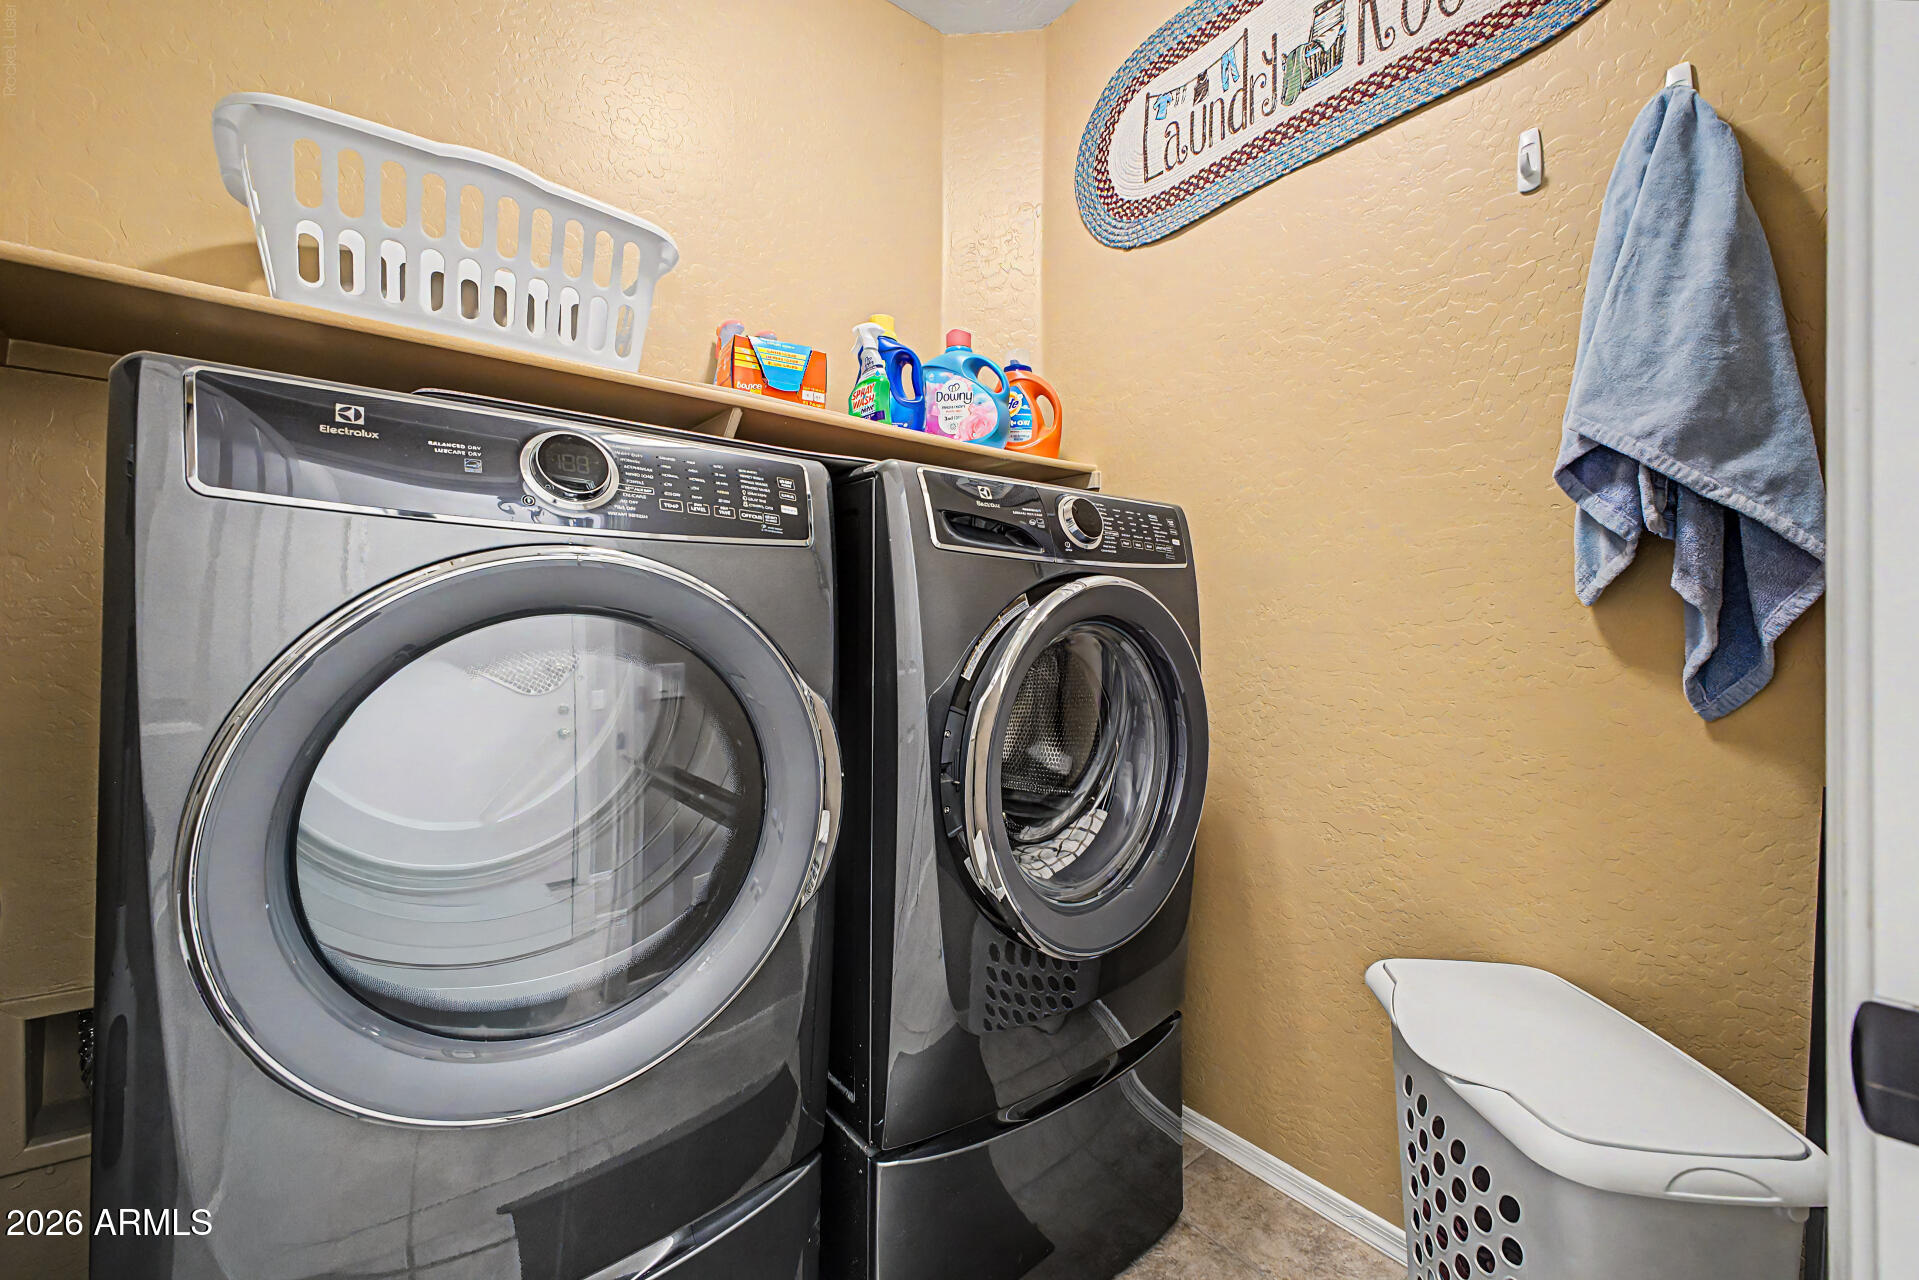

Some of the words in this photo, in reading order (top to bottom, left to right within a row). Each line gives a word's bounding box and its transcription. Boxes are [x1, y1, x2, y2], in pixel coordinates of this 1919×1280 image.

[1142, 27, 1279, 184] Laundry
[736, 381, 762, 390] bounce
[851, 382, 876, 401] SPRAY
[852, 393, 875, 410] WASH
[936, 391, 973, 405] Downy
[319, 424, 380, 440] Electrolux
[427, 440, 466, 449] BALANCED
